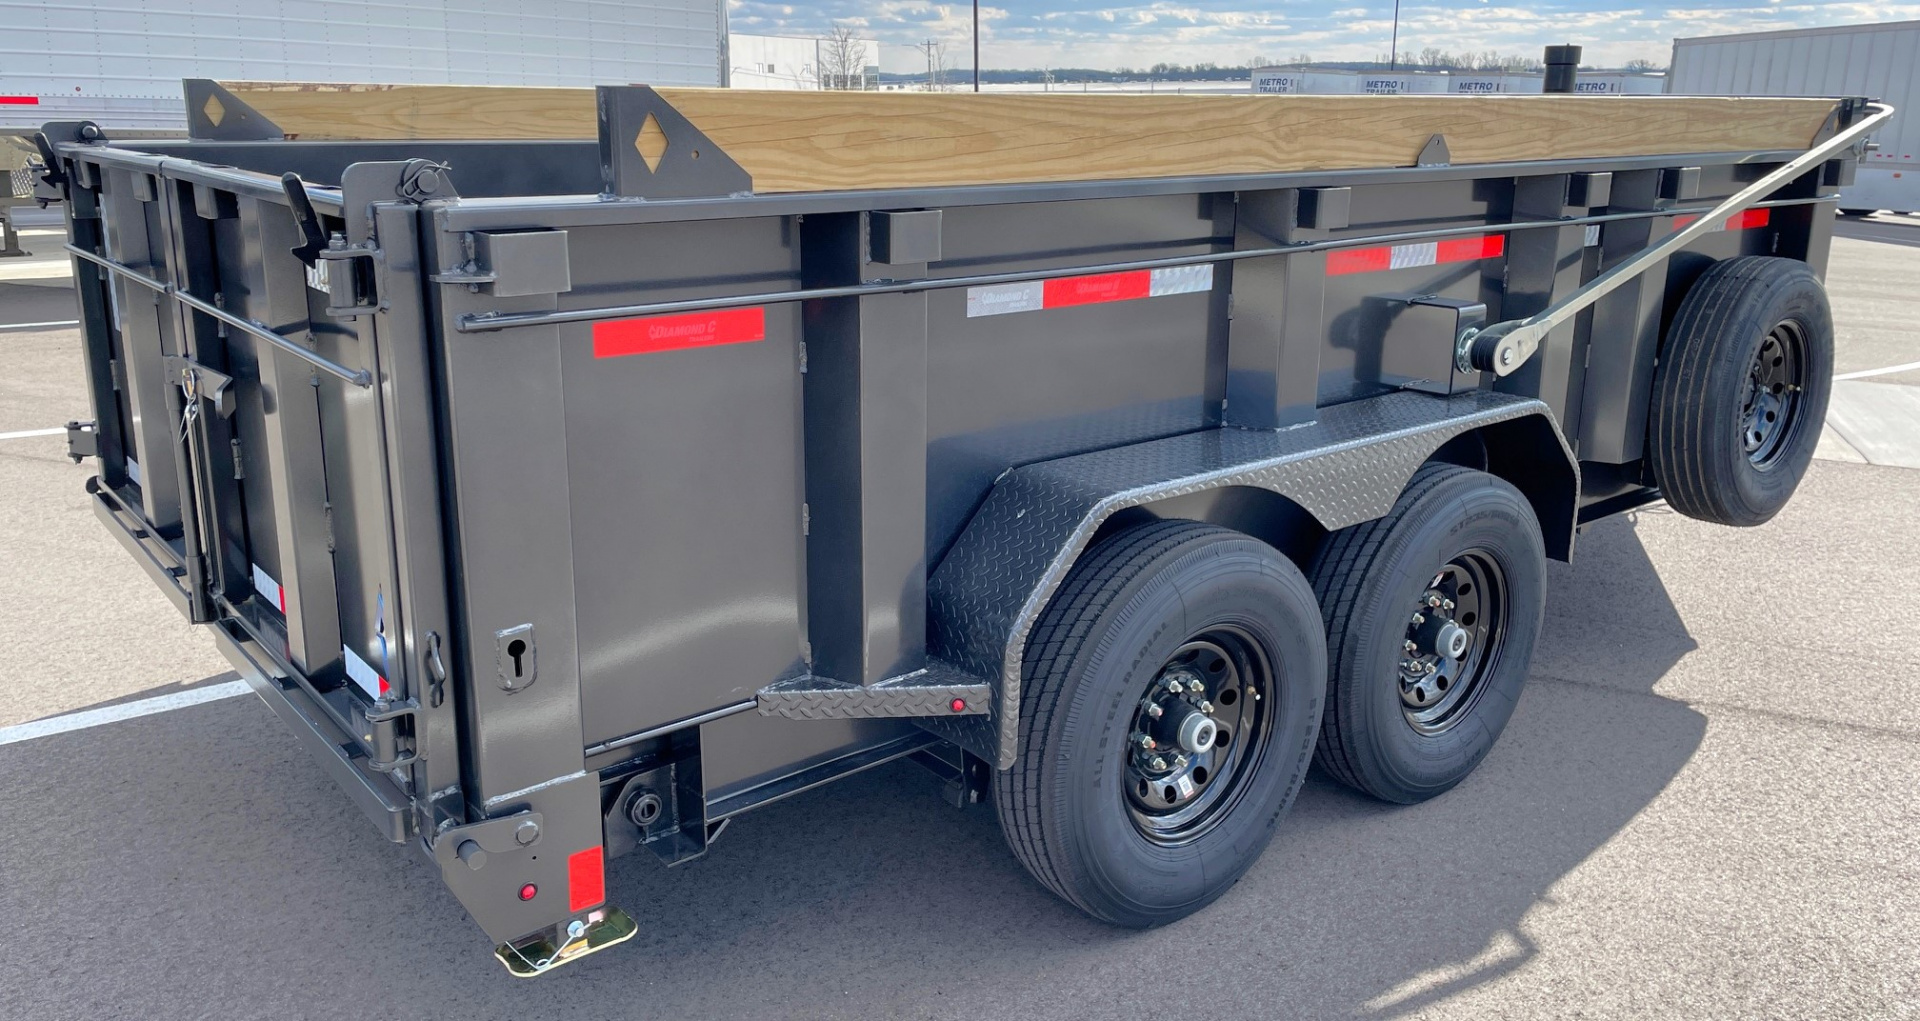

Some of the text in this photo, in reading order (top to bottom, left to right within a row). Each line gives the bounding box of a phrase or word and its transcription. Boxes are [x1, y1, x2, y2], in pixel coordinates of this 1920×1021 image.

[1259, 78, 1288, 86] METRO
[1366, 80, 1397, 89] METRO
[1458, 82, 1493, 90] METRO
[654, 320, 717, 339] DIAMOND C
[1093, 622, 1167, 788] ALL STEEL RADIAL
